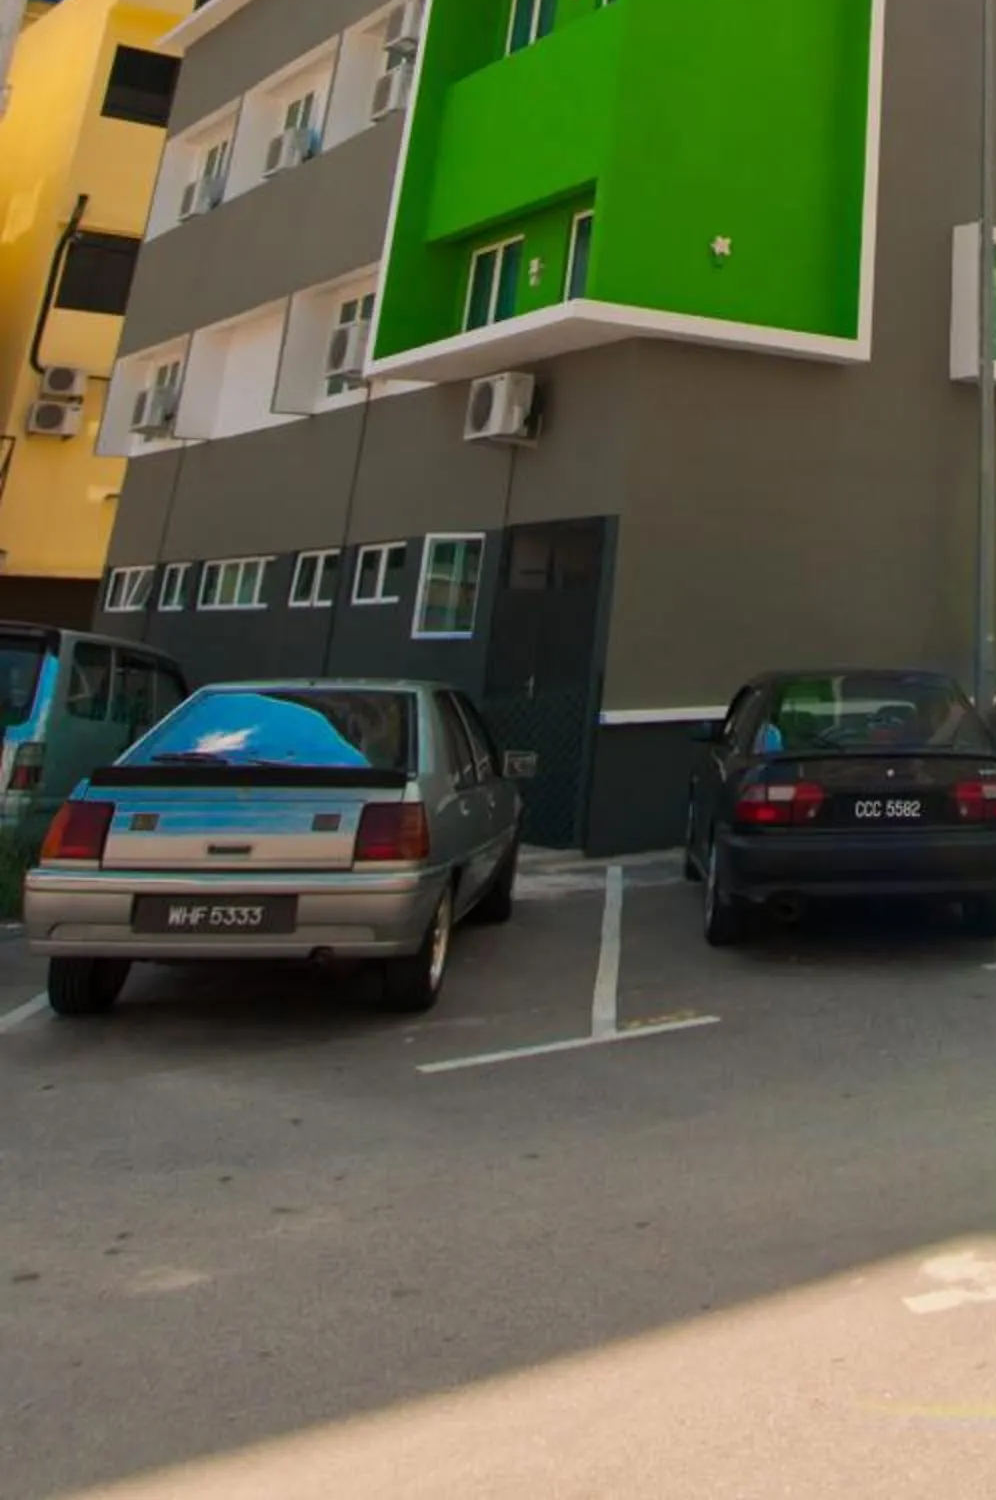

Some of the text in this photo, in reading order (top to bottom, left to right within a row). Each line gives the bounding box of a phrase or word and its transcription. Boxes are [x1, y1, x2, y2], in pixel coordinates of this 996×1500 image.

[855, 800, 922, 818] CCC 5582
[168, 905, 265, 926] WHF 5333
